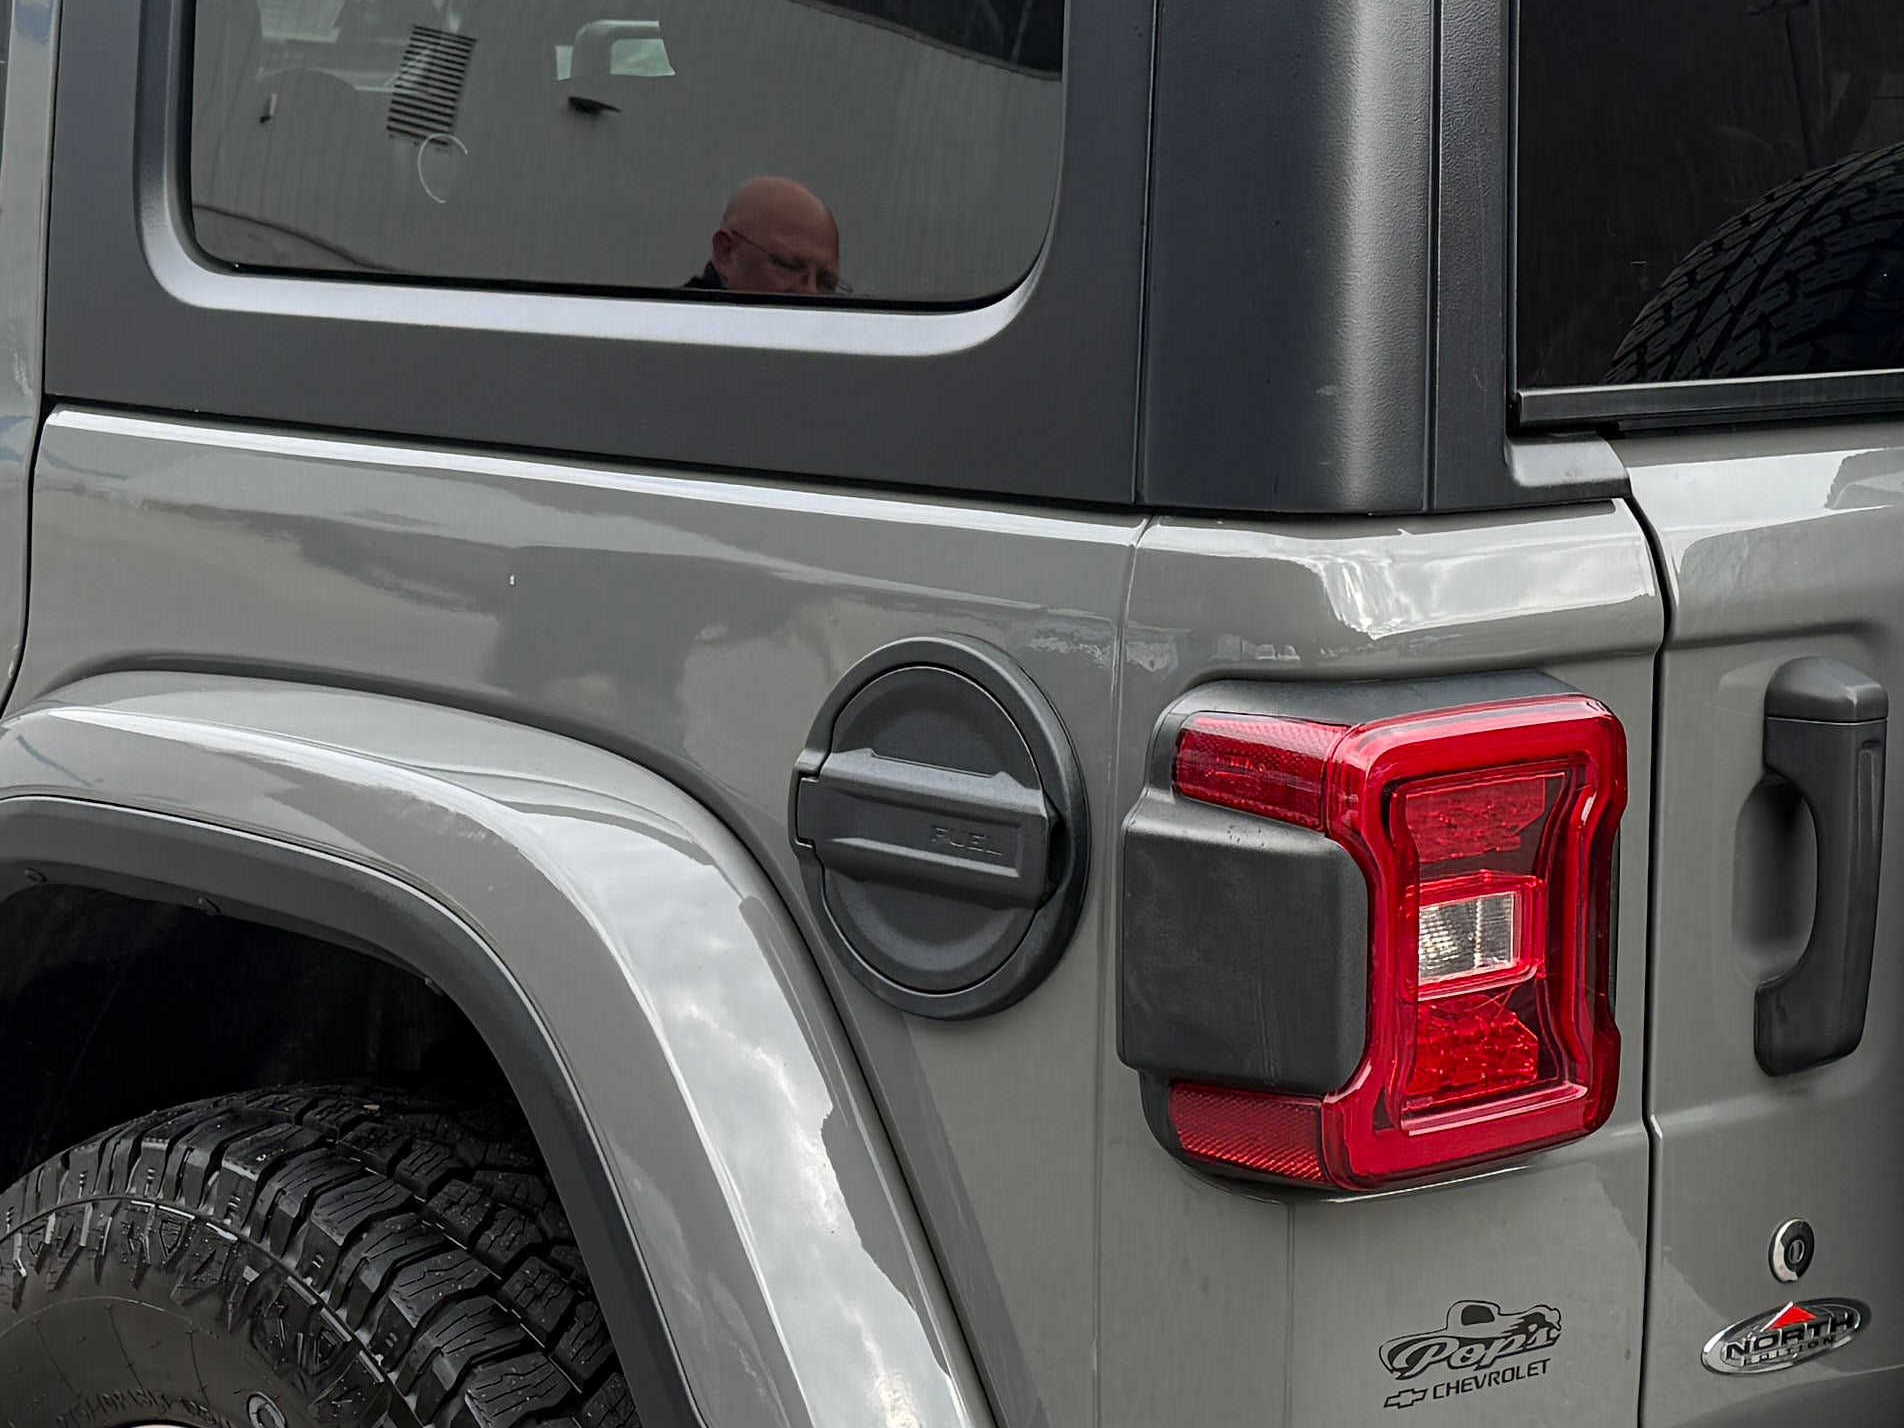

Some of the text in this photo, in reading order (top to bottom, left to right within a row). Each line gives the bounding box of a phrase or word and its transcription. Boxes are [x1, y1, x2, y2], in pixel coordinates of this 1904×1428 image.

[931, 825, 1003, 856] FUEL
[1723, 1312, 1855, 1360] NORTH
[1742, 1336, 1837, 1367] EDITION
[1433, 1358, 1552, 1400] CHEVROLET
